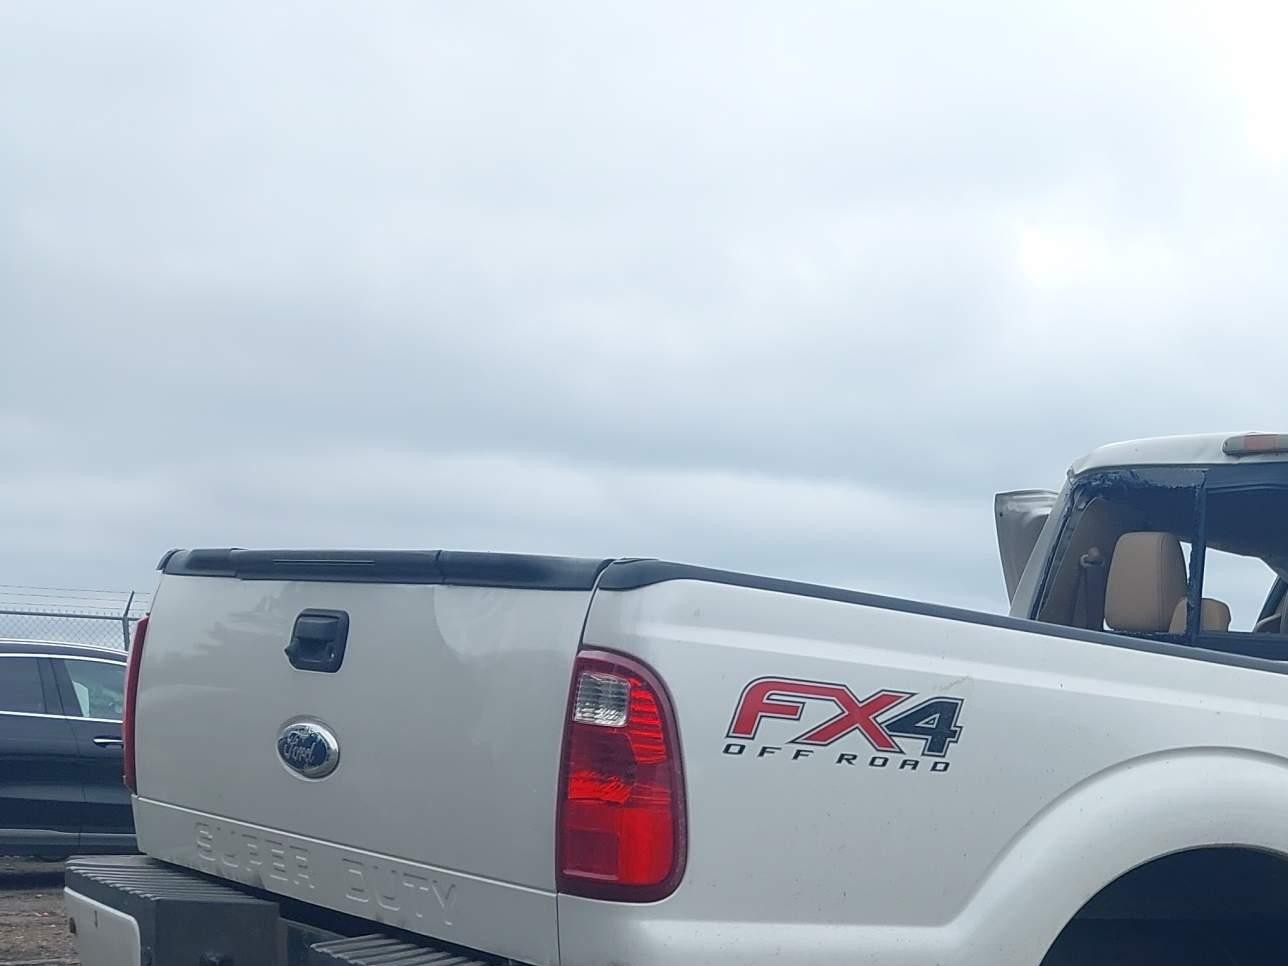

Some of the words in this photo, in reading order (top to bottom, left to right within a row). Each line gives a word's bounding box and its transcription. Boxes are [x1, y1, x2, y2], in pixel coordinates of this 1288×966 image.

[725, 676, 965, 758] FX4
[284, 731, 319, 764] Ford
[722, 743, 814, 761] OFF
[836, 752, 950, 773] ROAD
[195, 822, 316, 889] SUPER
[341, 857, 456, 926] DUTY
